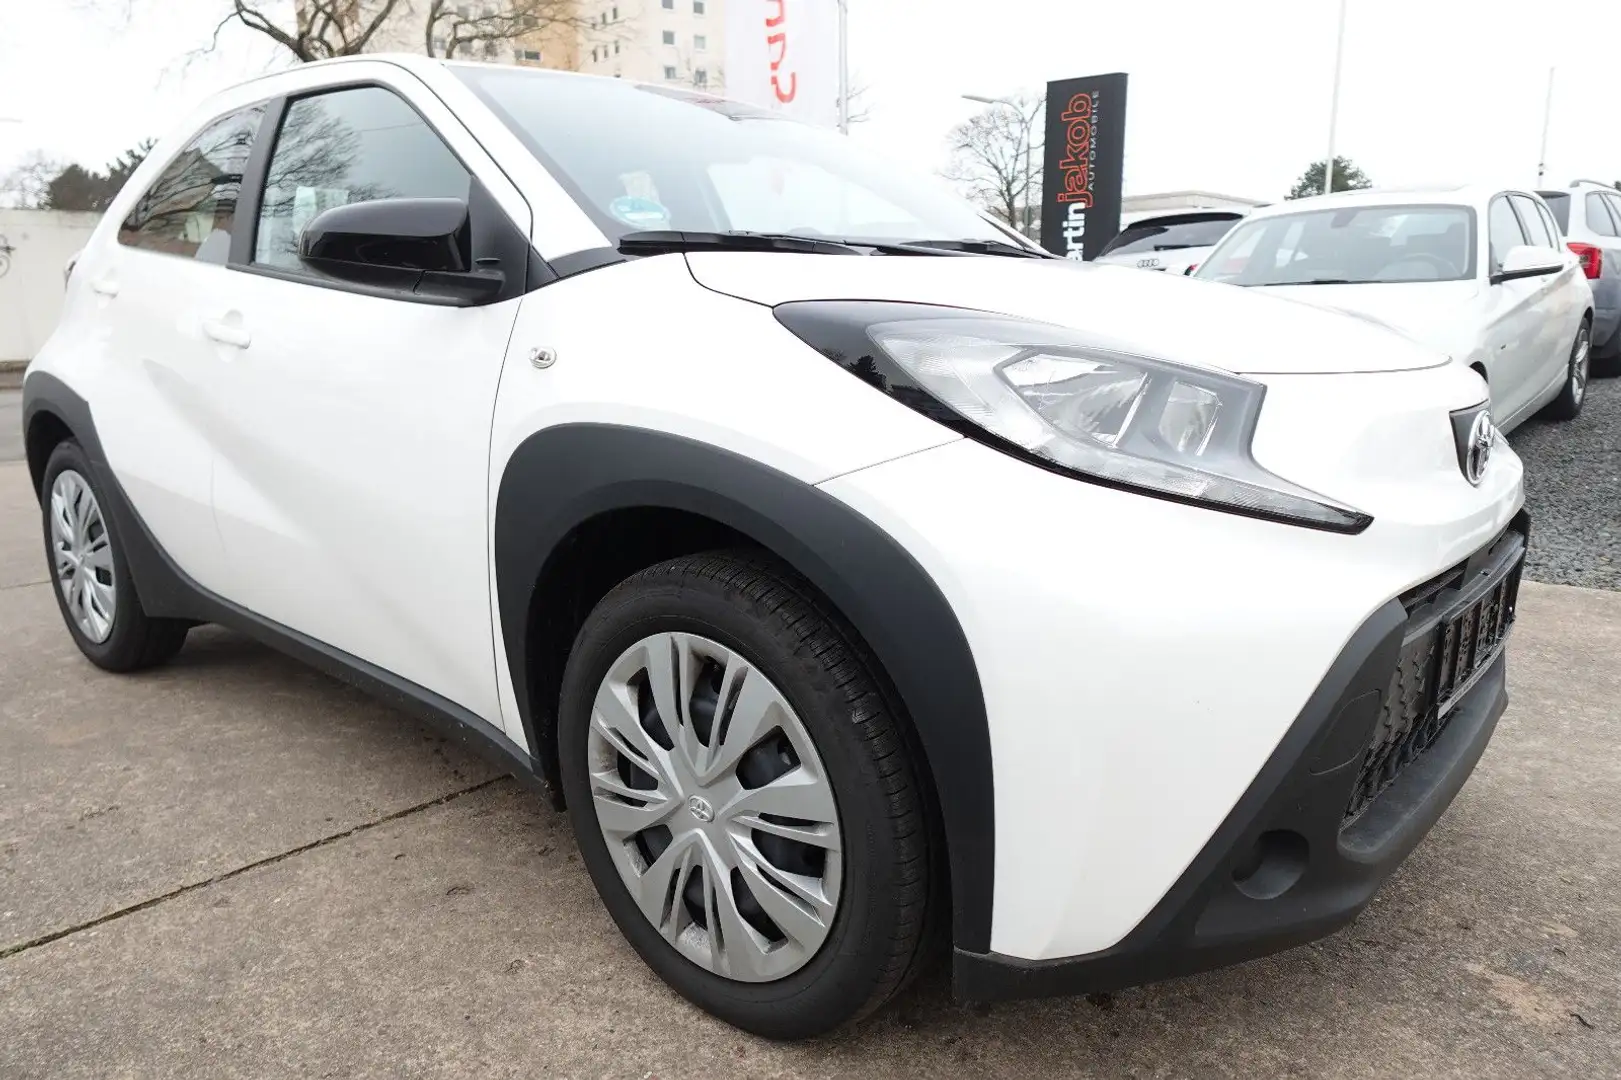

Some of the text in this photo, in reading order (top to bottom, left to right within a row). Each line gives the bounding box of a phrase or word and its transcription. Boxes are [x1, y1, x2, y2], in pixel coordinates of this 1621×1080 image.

[1057, 93, 1093, 261] artin jakob
[1088, 90, 1099, 191] AUTOMOBILE
